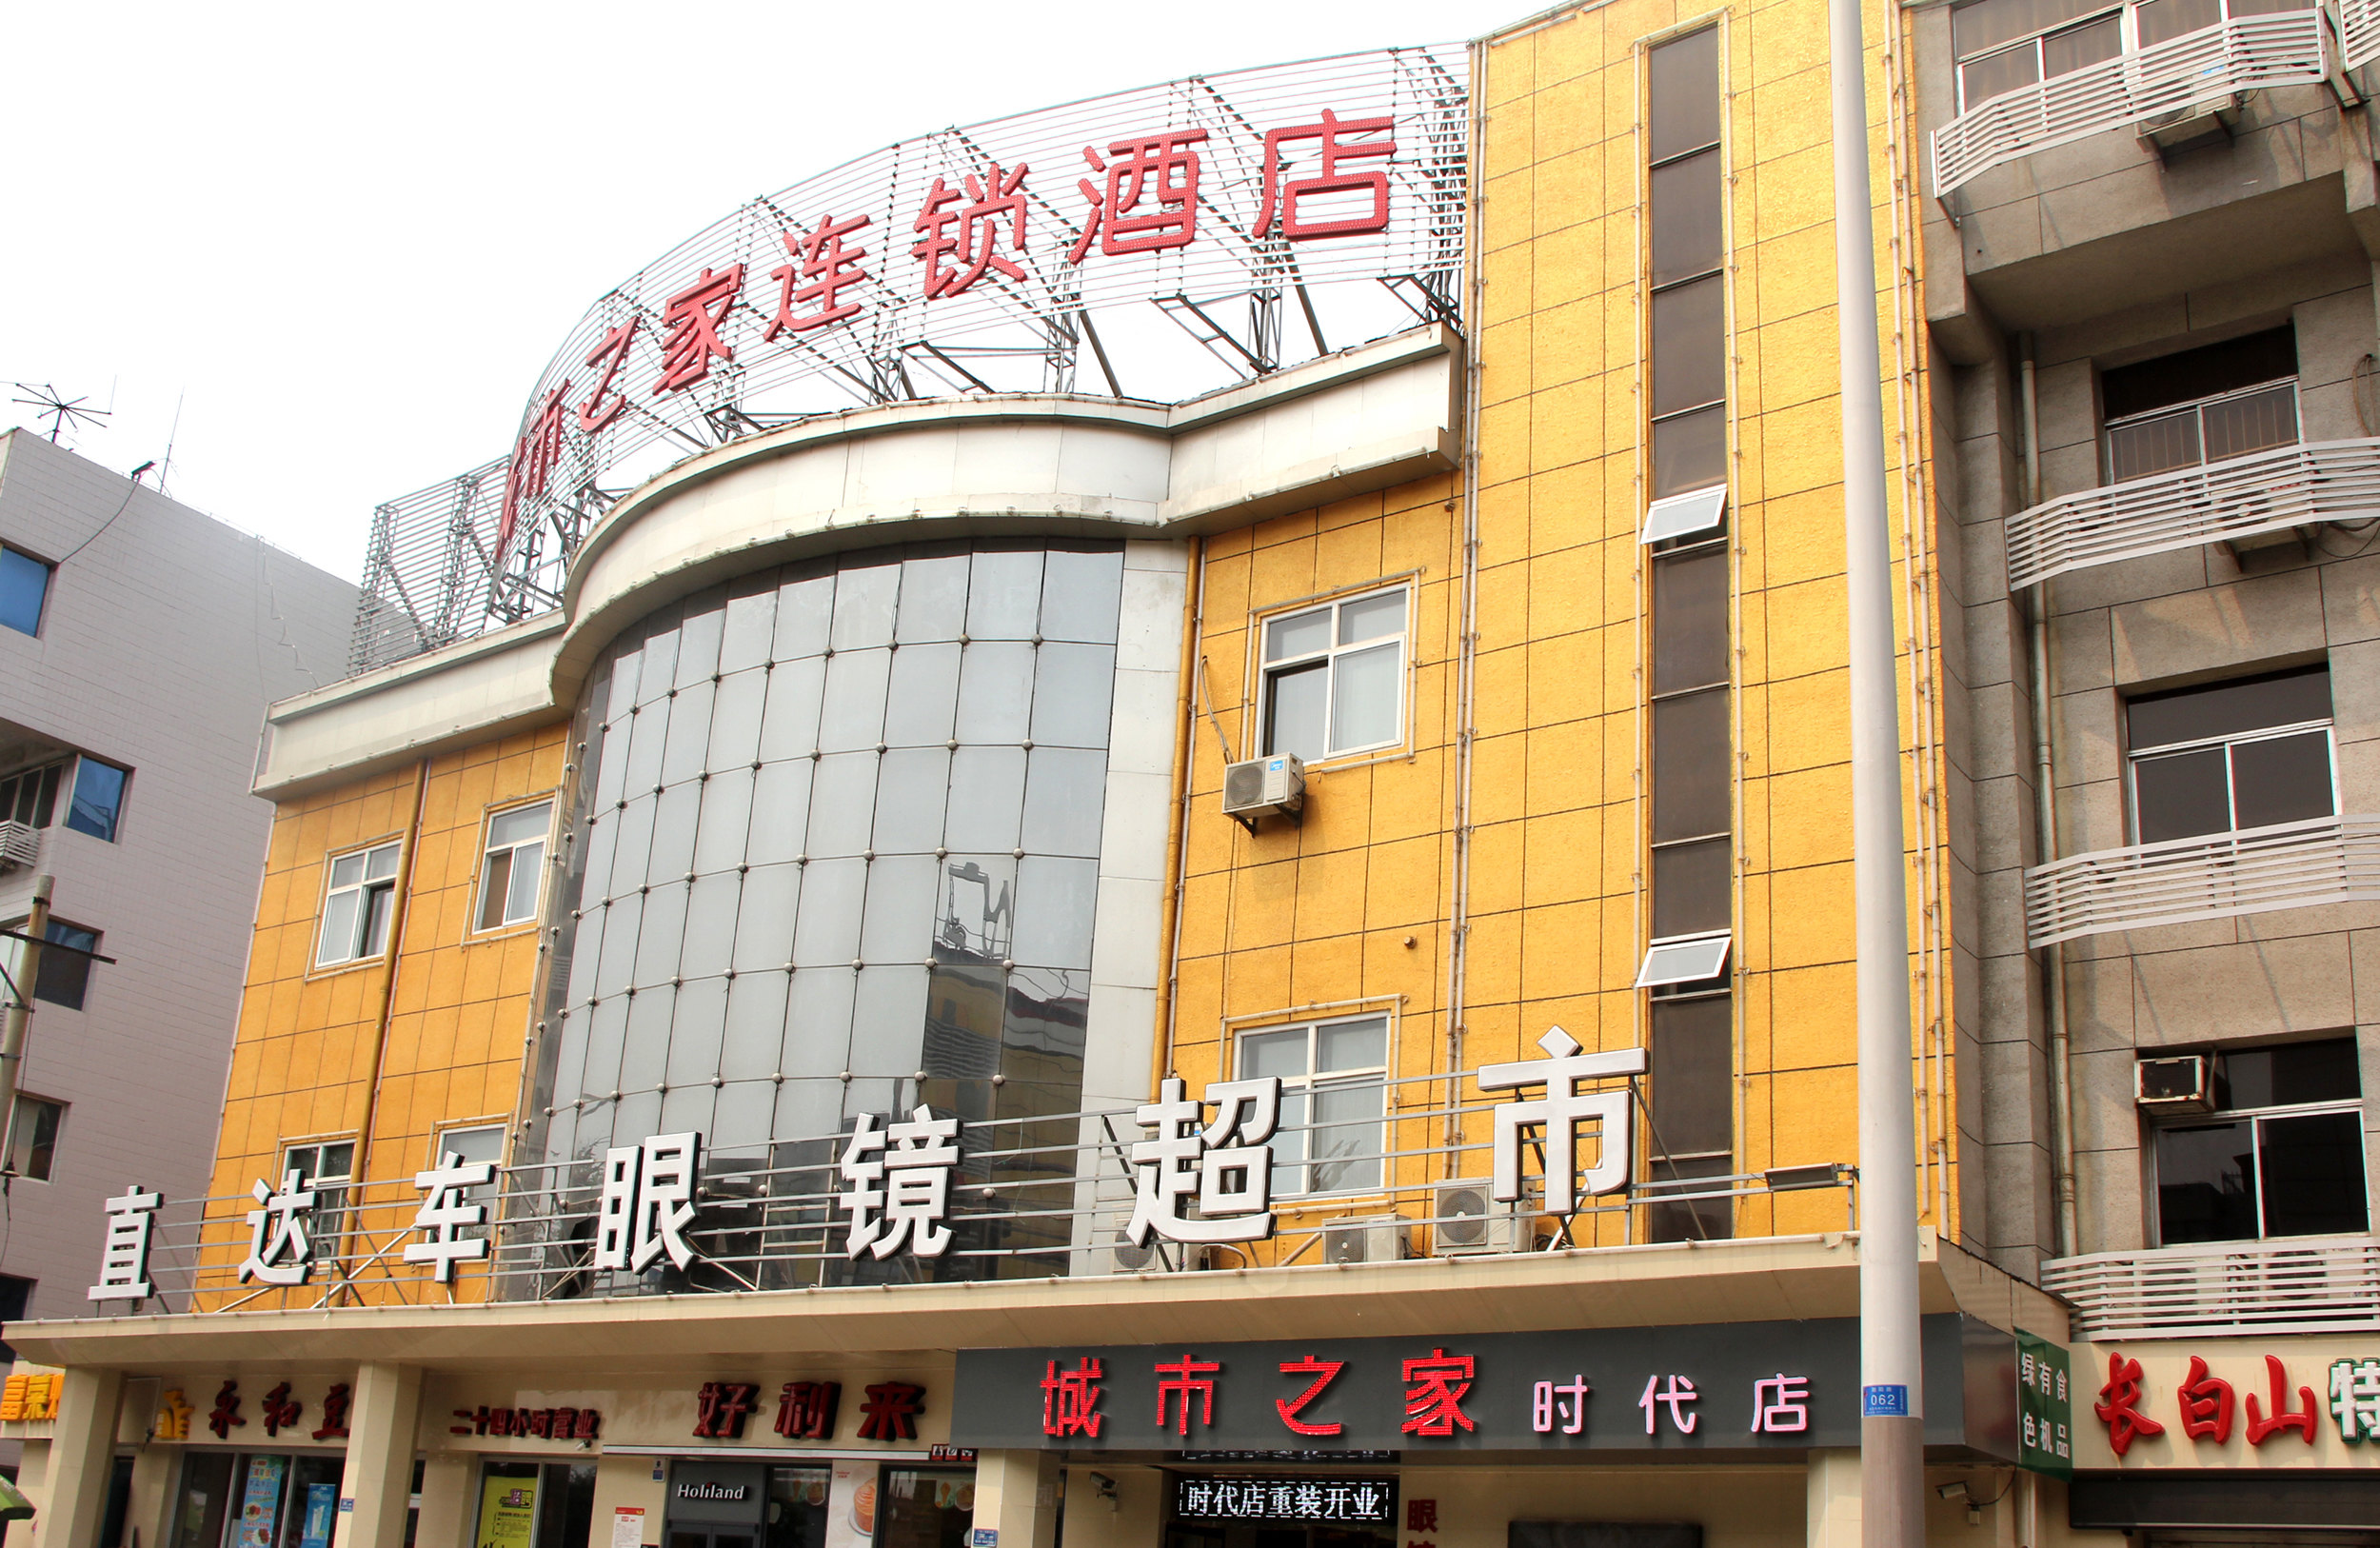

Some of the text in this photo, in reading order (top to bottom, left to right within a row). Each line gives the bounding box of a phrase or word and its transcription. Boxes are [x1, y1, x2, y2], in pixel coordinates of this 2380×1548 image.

[88, 1023, 1650, 1300] 直达车眼镜超市
[208, 1380, 349, 1440] 永和豆
[449, 1405, 601, 1439] 二十四小时营业
[692, 1380, 926, 1439] 好利来
[1040, 1347, 1808, 1438] 城市之家 时代店
[1871, 1393, 1895, 1406] 062
[2093, 1351, 2317, 1457] 长白山
[677, 1481, 745, 1499] Holiland
[1188, 1483, 1380, 1518] 时代店重装开业
